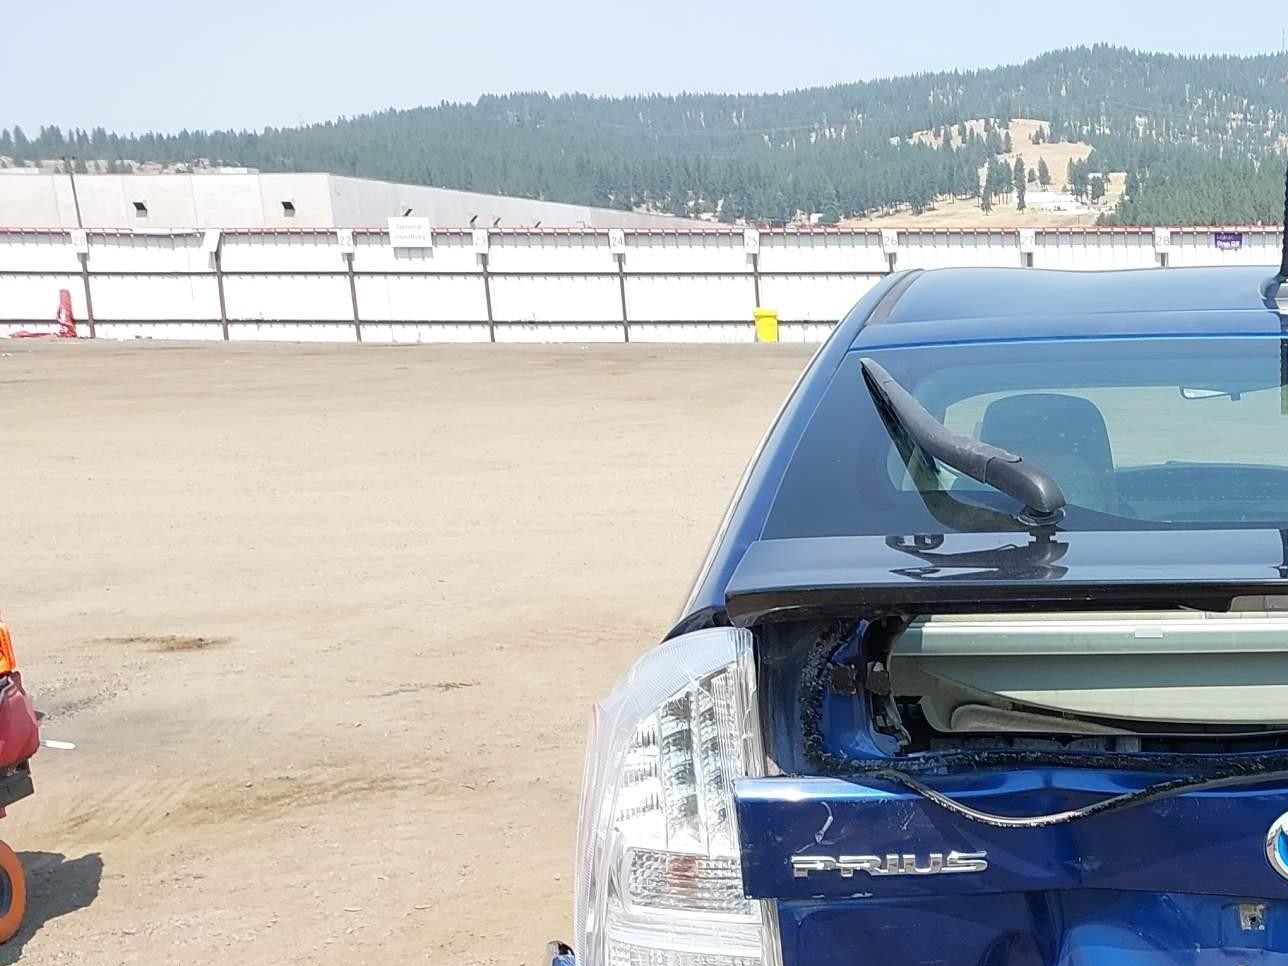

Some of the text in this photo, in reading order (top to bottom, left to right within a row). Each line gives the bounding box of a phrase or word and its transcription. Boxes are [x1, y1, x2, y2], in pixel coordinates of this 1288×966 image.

[340, 236, 352, 247] 22
[611, 236, 623, 247] 24
[746, 236, 758, 247] 25
[884, 236, 897, 247] 26
[1021, 236, 1034, 247] 27
[1156, 236, 1169, 247] 28
[790, 849, 988, 879] PRIUS
